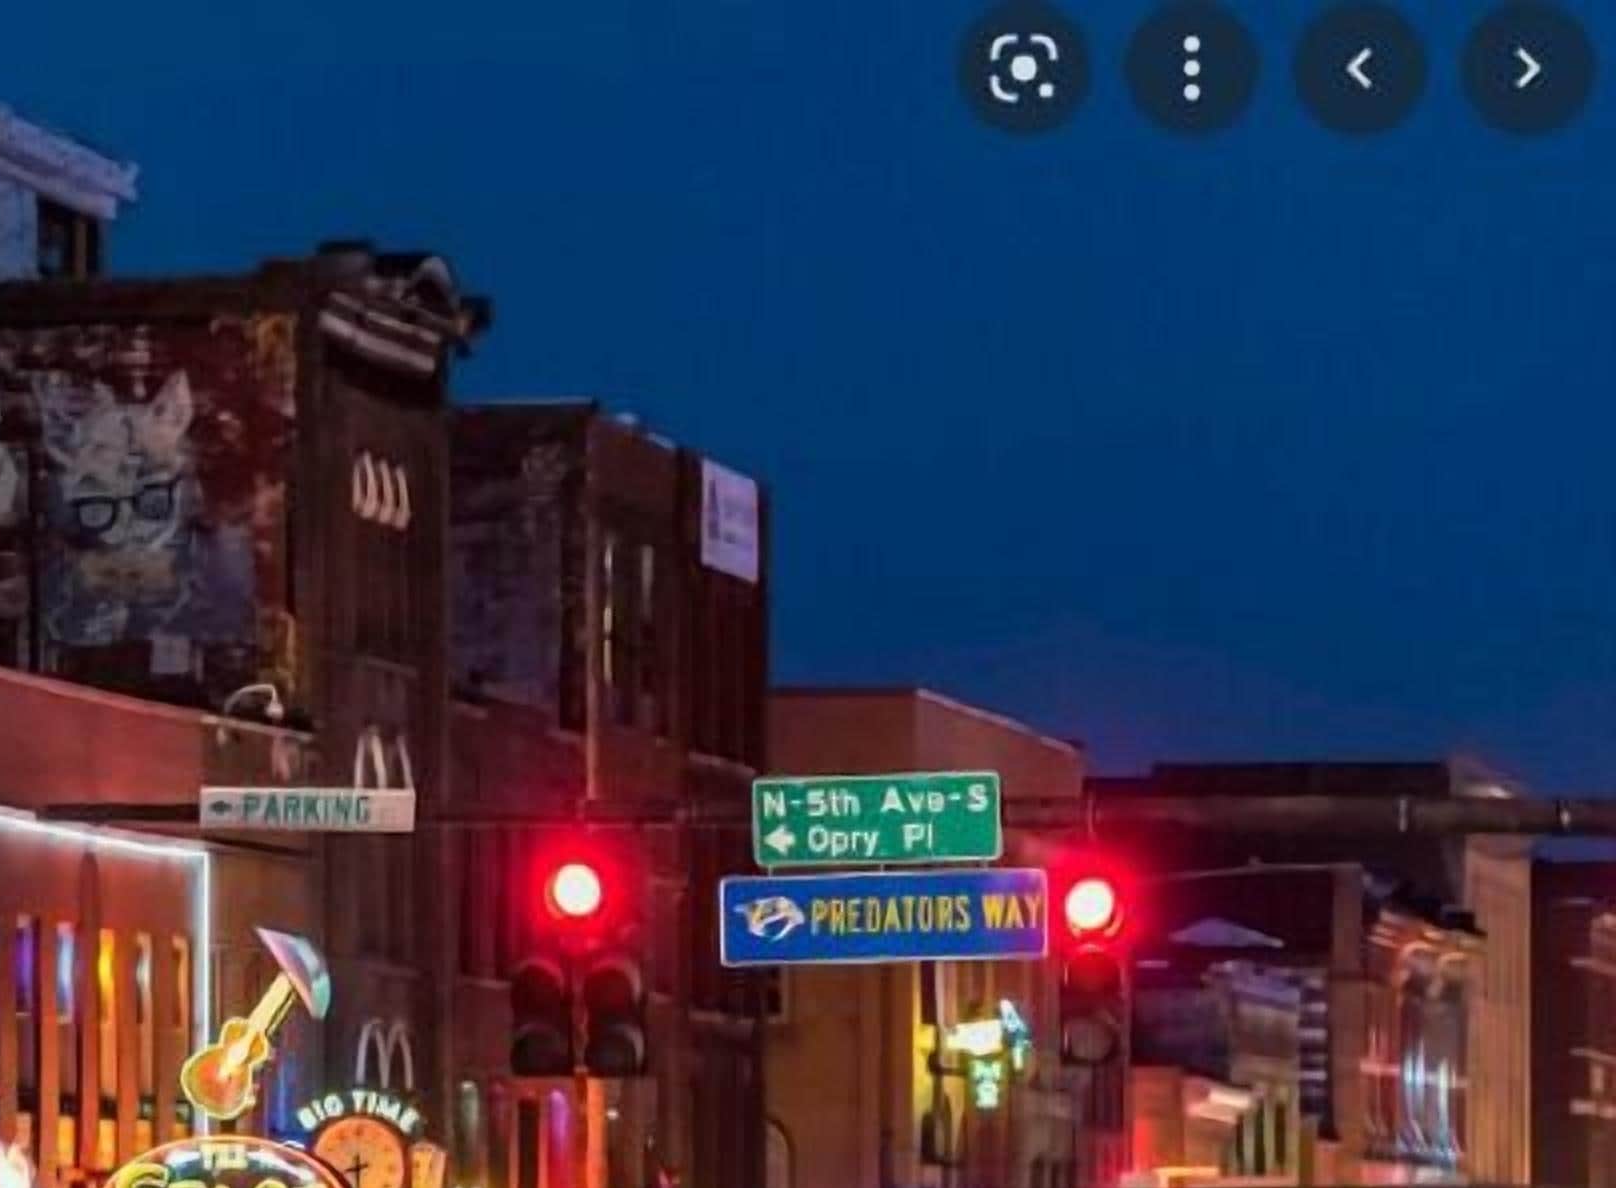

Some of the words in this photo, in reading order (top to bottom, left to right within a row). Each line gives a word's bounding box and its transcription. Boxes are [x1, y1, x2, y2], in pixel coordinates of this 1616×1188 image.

[242, 795, 371, 825] PARKING
[762, 788, 862, 818] N-5th
[880, 783, 990, 814] Ave-S
[807, 823, 882, 857] Opry
[809, 894, 970, 937] PREDATORS
[982, 893, 1043, 930] WAY
